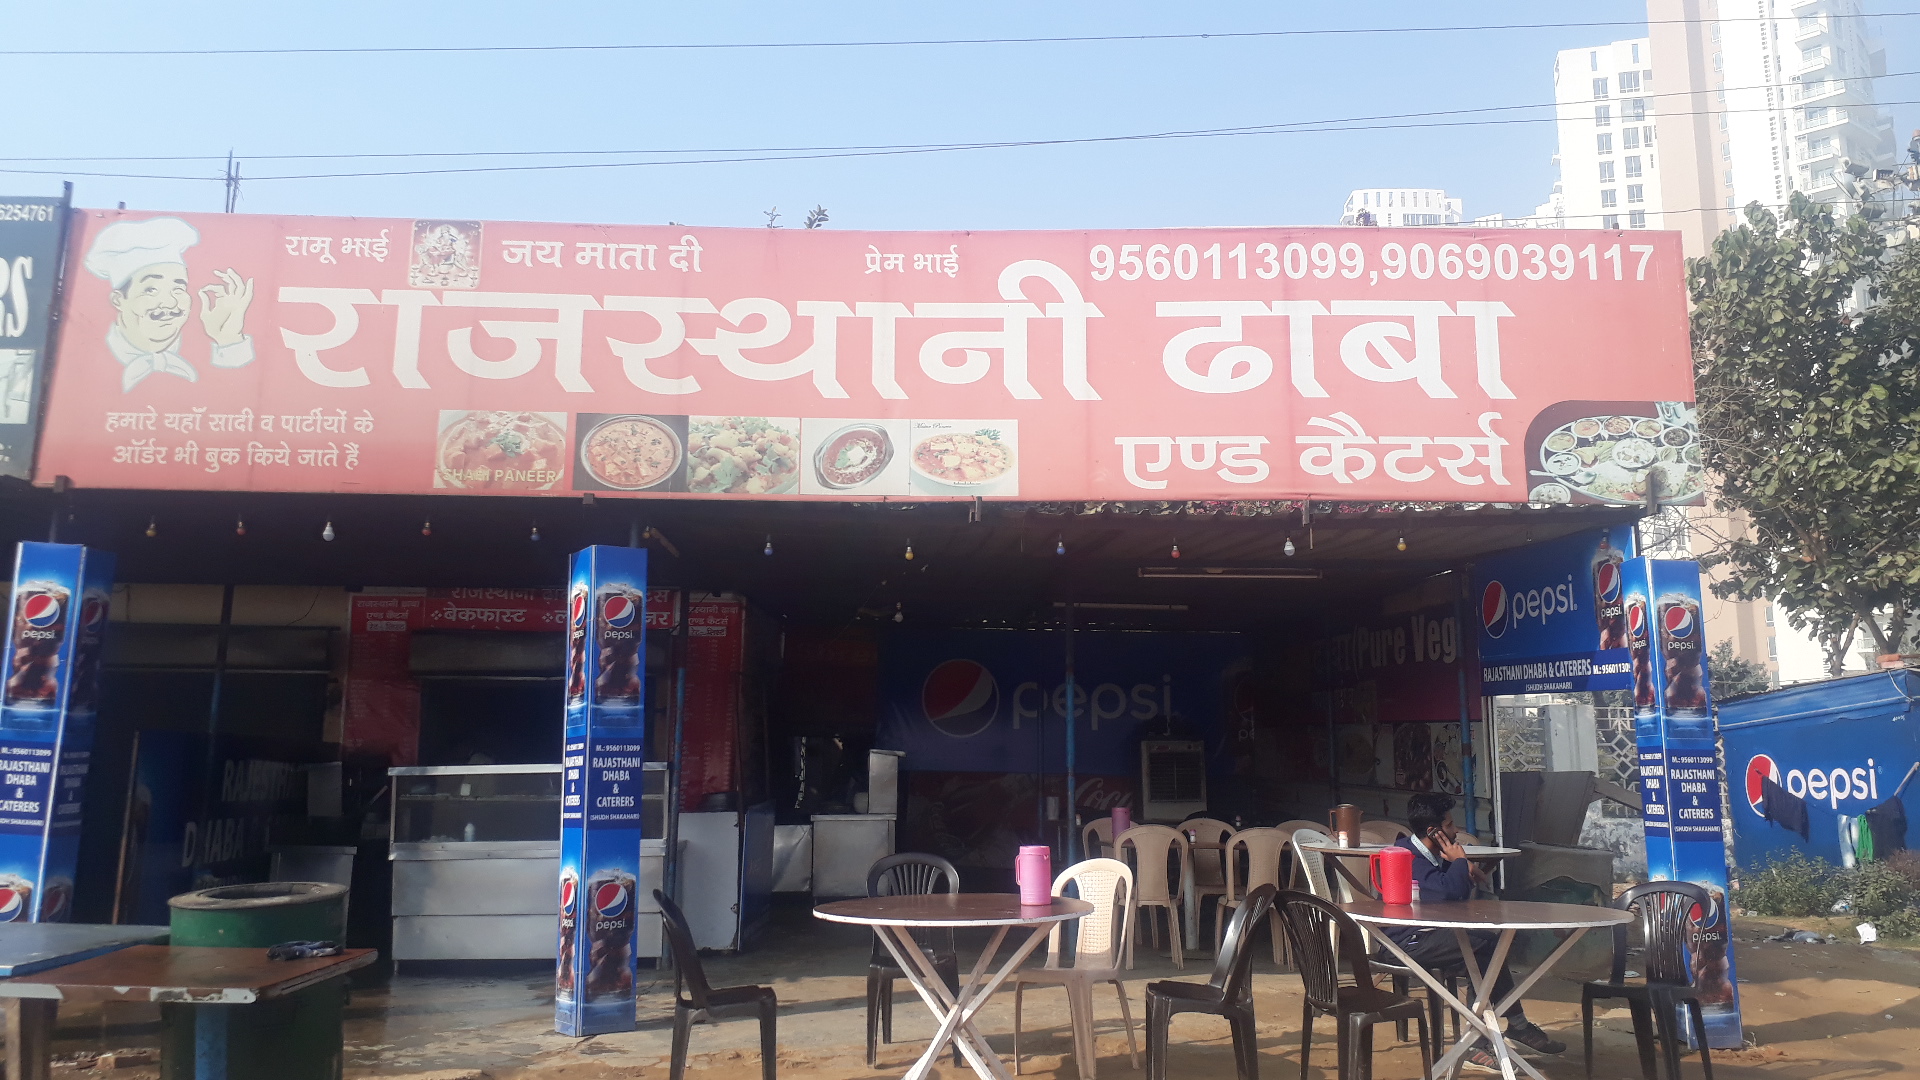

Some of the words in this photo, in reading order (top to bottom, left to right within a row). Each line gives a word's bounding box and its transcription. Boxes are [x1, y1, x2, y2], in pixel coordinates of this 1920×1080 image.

[286, 236, 337, 264] रामू
[341, 229, 390, 263] भाई
[502, 240, 563, 268] जय
[576, 243, 658, 270] माता
[669, 235, 704, 273] दी
[865, 245, 906, 274] प्रेम
[914, 245, 959, 279] भाई
[1090, 242, 1654, 284] 9560113099,9069039117
[278, 259, 1106, 402] राजस्थानी
[1155, 298, 1517, 401] ढाबा
[105, 405, 158, 433] हमारे
[209, 408, 255, 433] सादी
[260, 414, 276, 433] व
[353, 409, 375, 434] के
[174, 440, 201, 465] भी
[205, 447, 241, 473] बुक
[247, 440, 293, 467] किये
[297, 441, 340, 468] जाते
[342, 442, 361, 471] हैं
[1114, 435, 1271, 490] एण्ड
[1295, 411, 1512, 487] कैटर्स
[494, 470, 557, 483] PANEER
[1512, 574, 1574, 630] pepsi
[1601, 603, 1622, 619] pepsi
[22, 629, 55, 640] pepsi
[604, 630, 633, 640] pepsi
[1667, 641, 1694, 651] pepsi
[1483, 665, 1523, 682] RAJASTHANI
[1523, 663, 1546, 680] DHABA
[1548, 663, 1554, 677] &
[1554, 658, 1592, 678] CATERERS
[1012, 674, 1172, 731] pepsi
[593, 757, 640, 768] RAJASTHANI
[5, 773, 37, 786] DHABA
[602, 770, 630, 782] DHABA
[1670, 769, 1715, 780] RAJASTHANI
[15, 787, 24, 799] &
[612, 783, 620, 794] &
[1681, 782, 1707, 793] DHABA
[596, 796, 634, 808] CATERERS
[1692, 795, 1699, 806] &
[1678, 808, 1714, 820] CATERERS
[596, 919, 625, 932] pepsi
